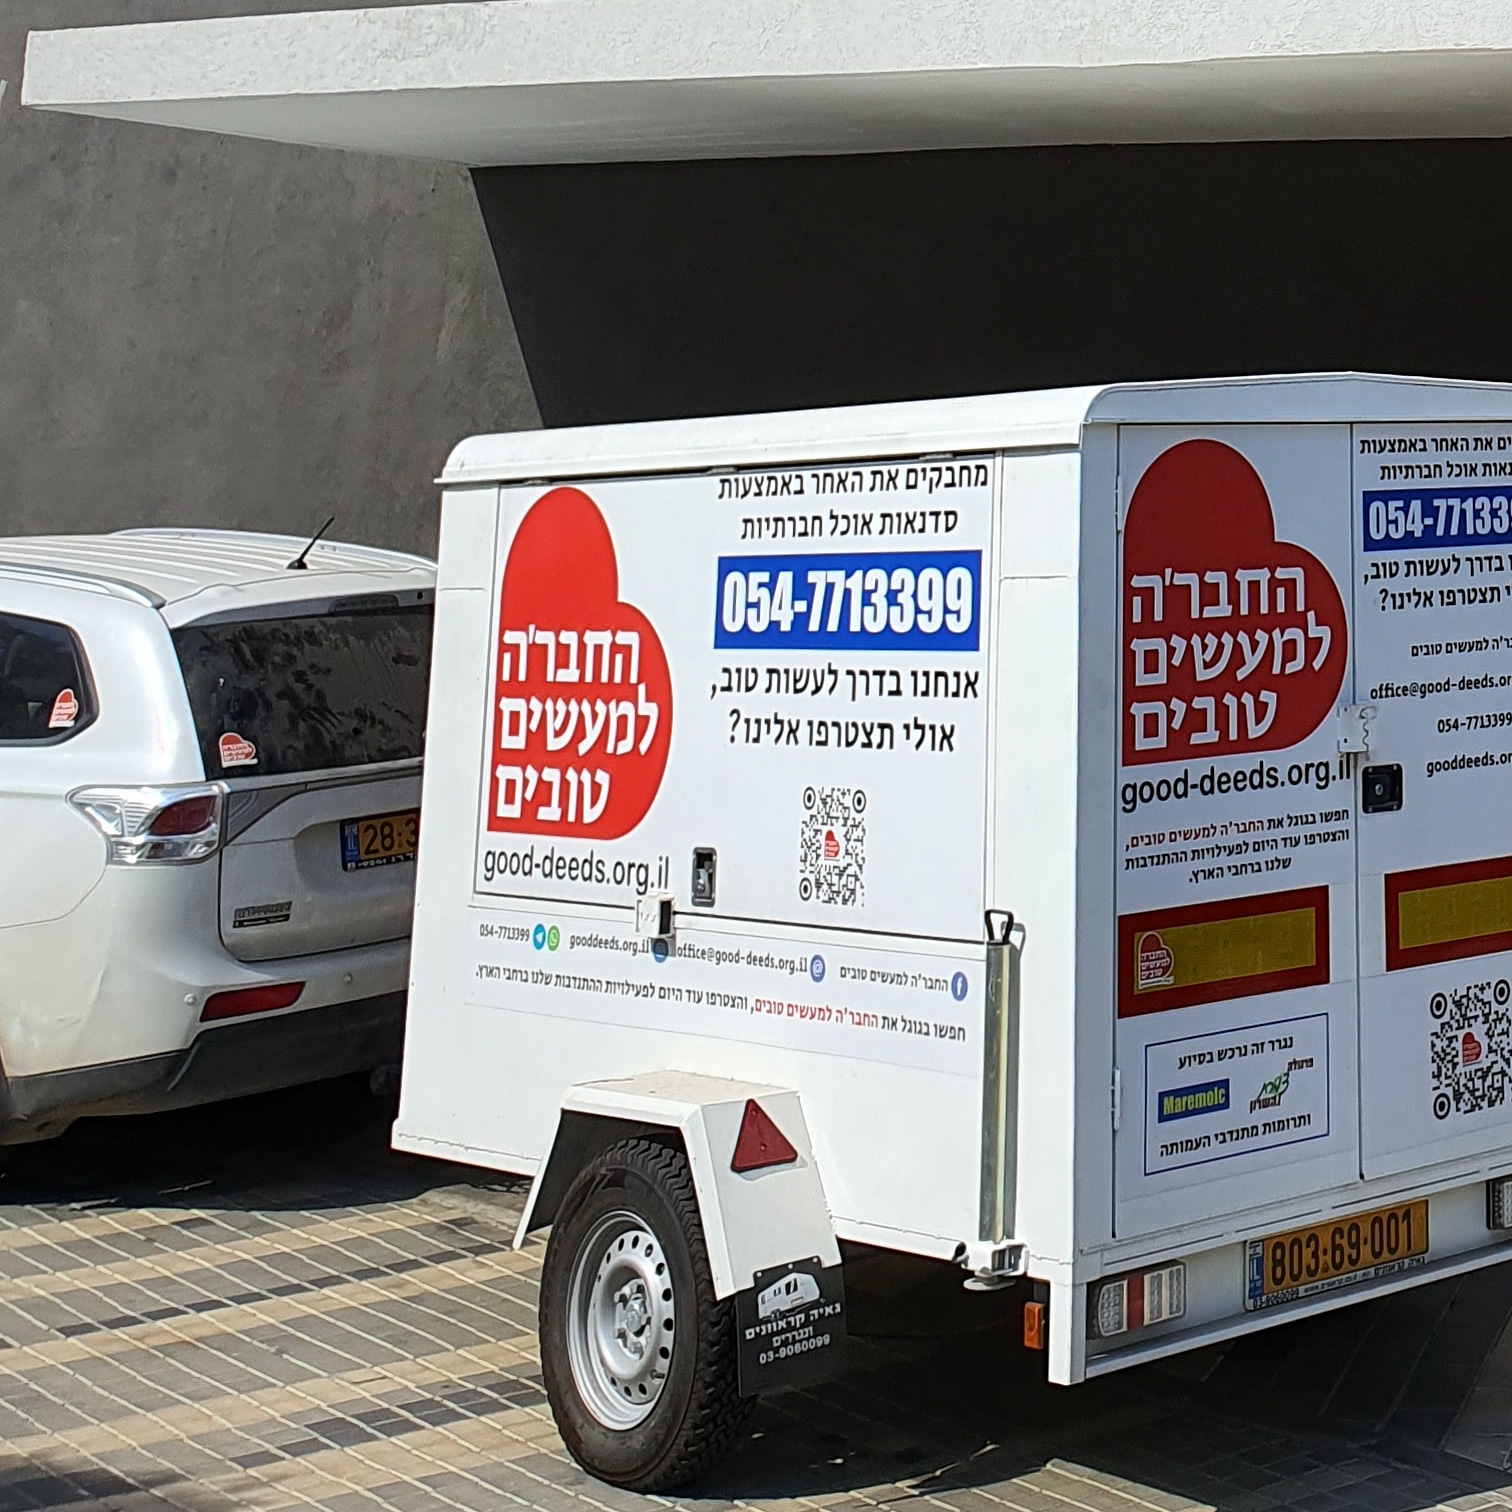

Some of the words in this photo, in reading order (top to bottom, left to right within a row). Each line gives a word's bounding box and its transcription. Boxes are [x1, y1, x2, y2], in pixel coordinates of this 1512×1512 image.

[1360, 438, 1427, 454] באמצעות
[1431, 437, 1469, 452] האחר
[1473, 437, 1493, 451] את
[906, 464, 987, 494] מחבקים
[1380, 464, 1442, 480] חברתיות
[1447, 461, 1478, 478] אוכל
[718, 474, 804, 499] באמצעות
[811, 470, 863, 494] האחר
[870, 468, 899, 493] את
[741, 515, 822, 540] חברתיות
[830, 509, 873, 536] אוכל
[879, 510, 958, 535] סדנאות
[1364, 561, 1399, 585] טוב,
[1405, 554, 1460, 577] לעשות
[1466, 555, 1504, 576] בדרך
[722, 566, 973, 633] 054-7713399
[1131, 567, 1305, 623] החבר'ה
[1380, 587, 1434, 611] אלינו?
[1439, 587, 1500, 606] תצטרפו
[503, 624, 639, 684] החבר'ה
[1131, 610, 1331, 686] למעשים
[1412, 644, 1442, 657] טובים
[1446, 638, 1489, 654] למעשים
[710, 667, 758, 700] טוב,
[765, 662, 838, 696] לעשות
[846, 669, 902, 701] בדרך
[911, 670, 979, 699] אנחנו
[499, 683, 658, 756] למעשים
[729, 708, 800, 746] אלינו?
[1130, 689, 1277, 750] טובים
[1438, 712, 1512, 733] 054-7713399
[808, 719, 894, 750] תצטרפו
[903, 717, 955, 752] אולי
[495, 764, 610, 824] טובים
[1122, 754, 1350, 813] good-deeds.org.il
[1267, 817, 1283, 830] את
[1287, 814, 1316, 827] בגוגל
[1319, 809, 1349, 823] חפשו
[1169, 824, 1217, 842] למעשים
[1281, 835, 1300, 848] עוד
[1304, 829, 1349, 845] והצטרפו
[1191, 841, 1249, 861] לפעילויות
[1253, 841, 1278, 853] היום
[484, 844, 669, 895] good-deeds.org.il
[1125, 849, 1187, 870] ההתנדבות
[1228, 862, 1262, 876] ברחבי
[1265, 856, 1292, 871] שלנו
[480, 924, 530, 942] 054-7713399
[570, 933, 649, 957] gooddeeds.org.il
[677, 944, 808, 976] office@good-deeds.org.il
[503, 967, 528, 983] ברחבי
[531, 970, 552, 986] שלנו
[840, 965, 867, 980] טובים
[870, 968, 908, 986] למעשים
[659, 986, 682, 1002] היום
[686, 989, 703, 1004] עוד
[706, 990, 748, 1010] והצטרפו
[787, 1003, 832, 1022] למעשים
[882, 1014, 898, 1030] את
[901, 1014, 930, 1037] בגוגל
[934, 1022, 966, 1042] חפשו
[1218, 1045, 1247, 1061] נרכש
[1251, 1042, 1265, 1054] זה
[1268, 1036, 1293, 1051] נגרר
[1178, 1051, 1214, 1070] בסיוע
[1262, 1113, 1311, 1134] ותרומות
[1214, 1125, 1259, 1144] מתנדבי
[1160, 1135, 1211, 1157] העמותה
[745, 1313, 805, 1340] קראוונים
